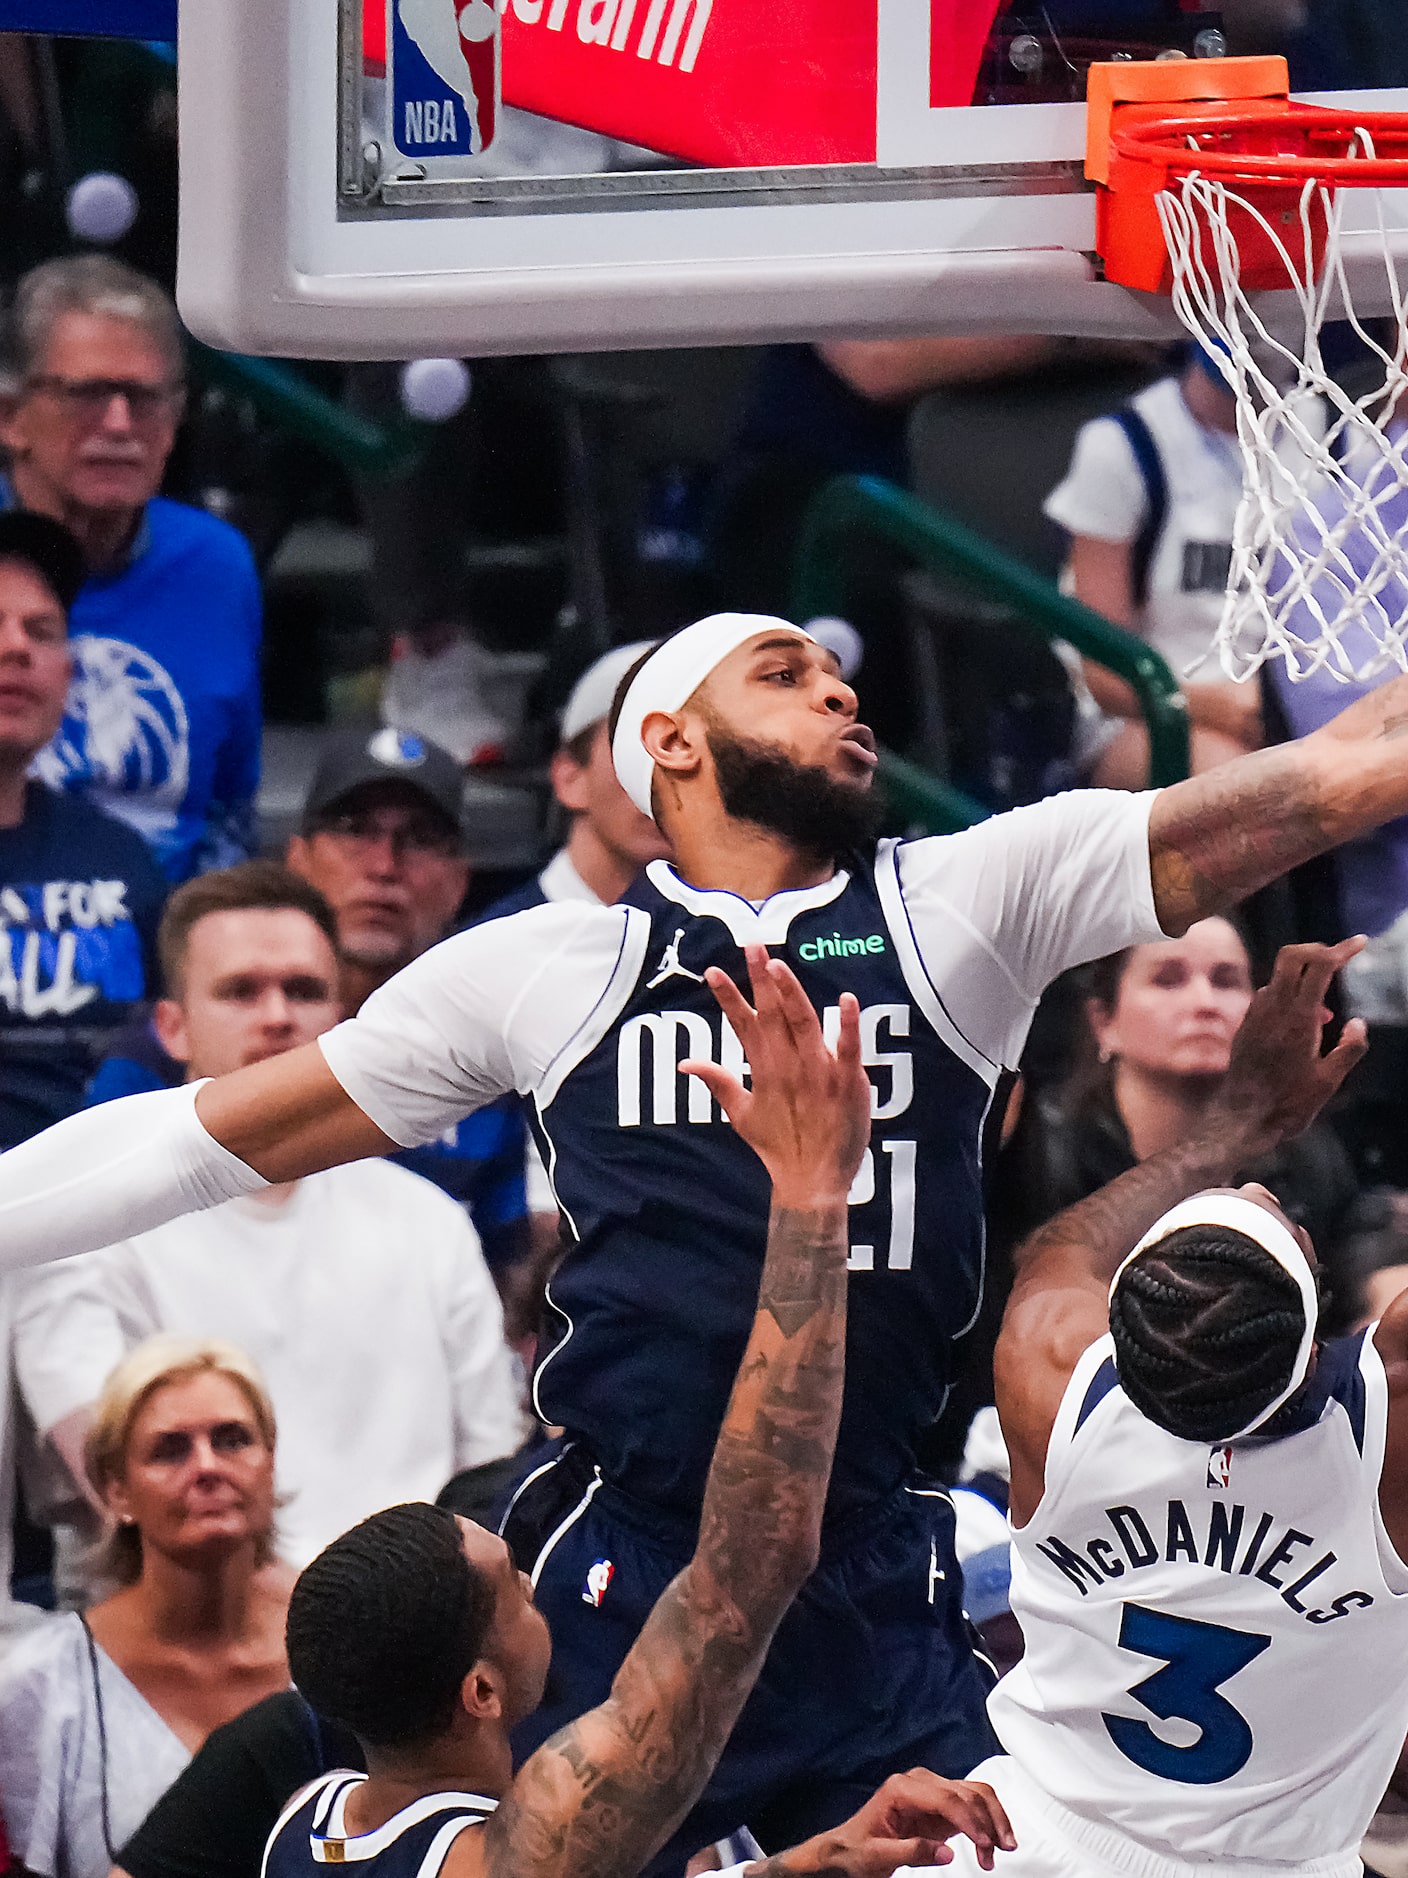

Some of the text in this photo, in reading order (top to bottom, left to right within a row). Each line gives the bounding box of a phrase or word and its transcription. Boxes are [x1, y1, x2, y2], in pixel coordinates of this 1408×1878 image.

[404, 99, 458, 144] NBA
[42, 878, 133, 932] FOR
[799, 931, 886, 962] chime
[617, 1003, 915, 1127] MS
[1035, 1499, 1375, 1625] McDANIELS
[1101, 1600, 1273, 1786] 3
